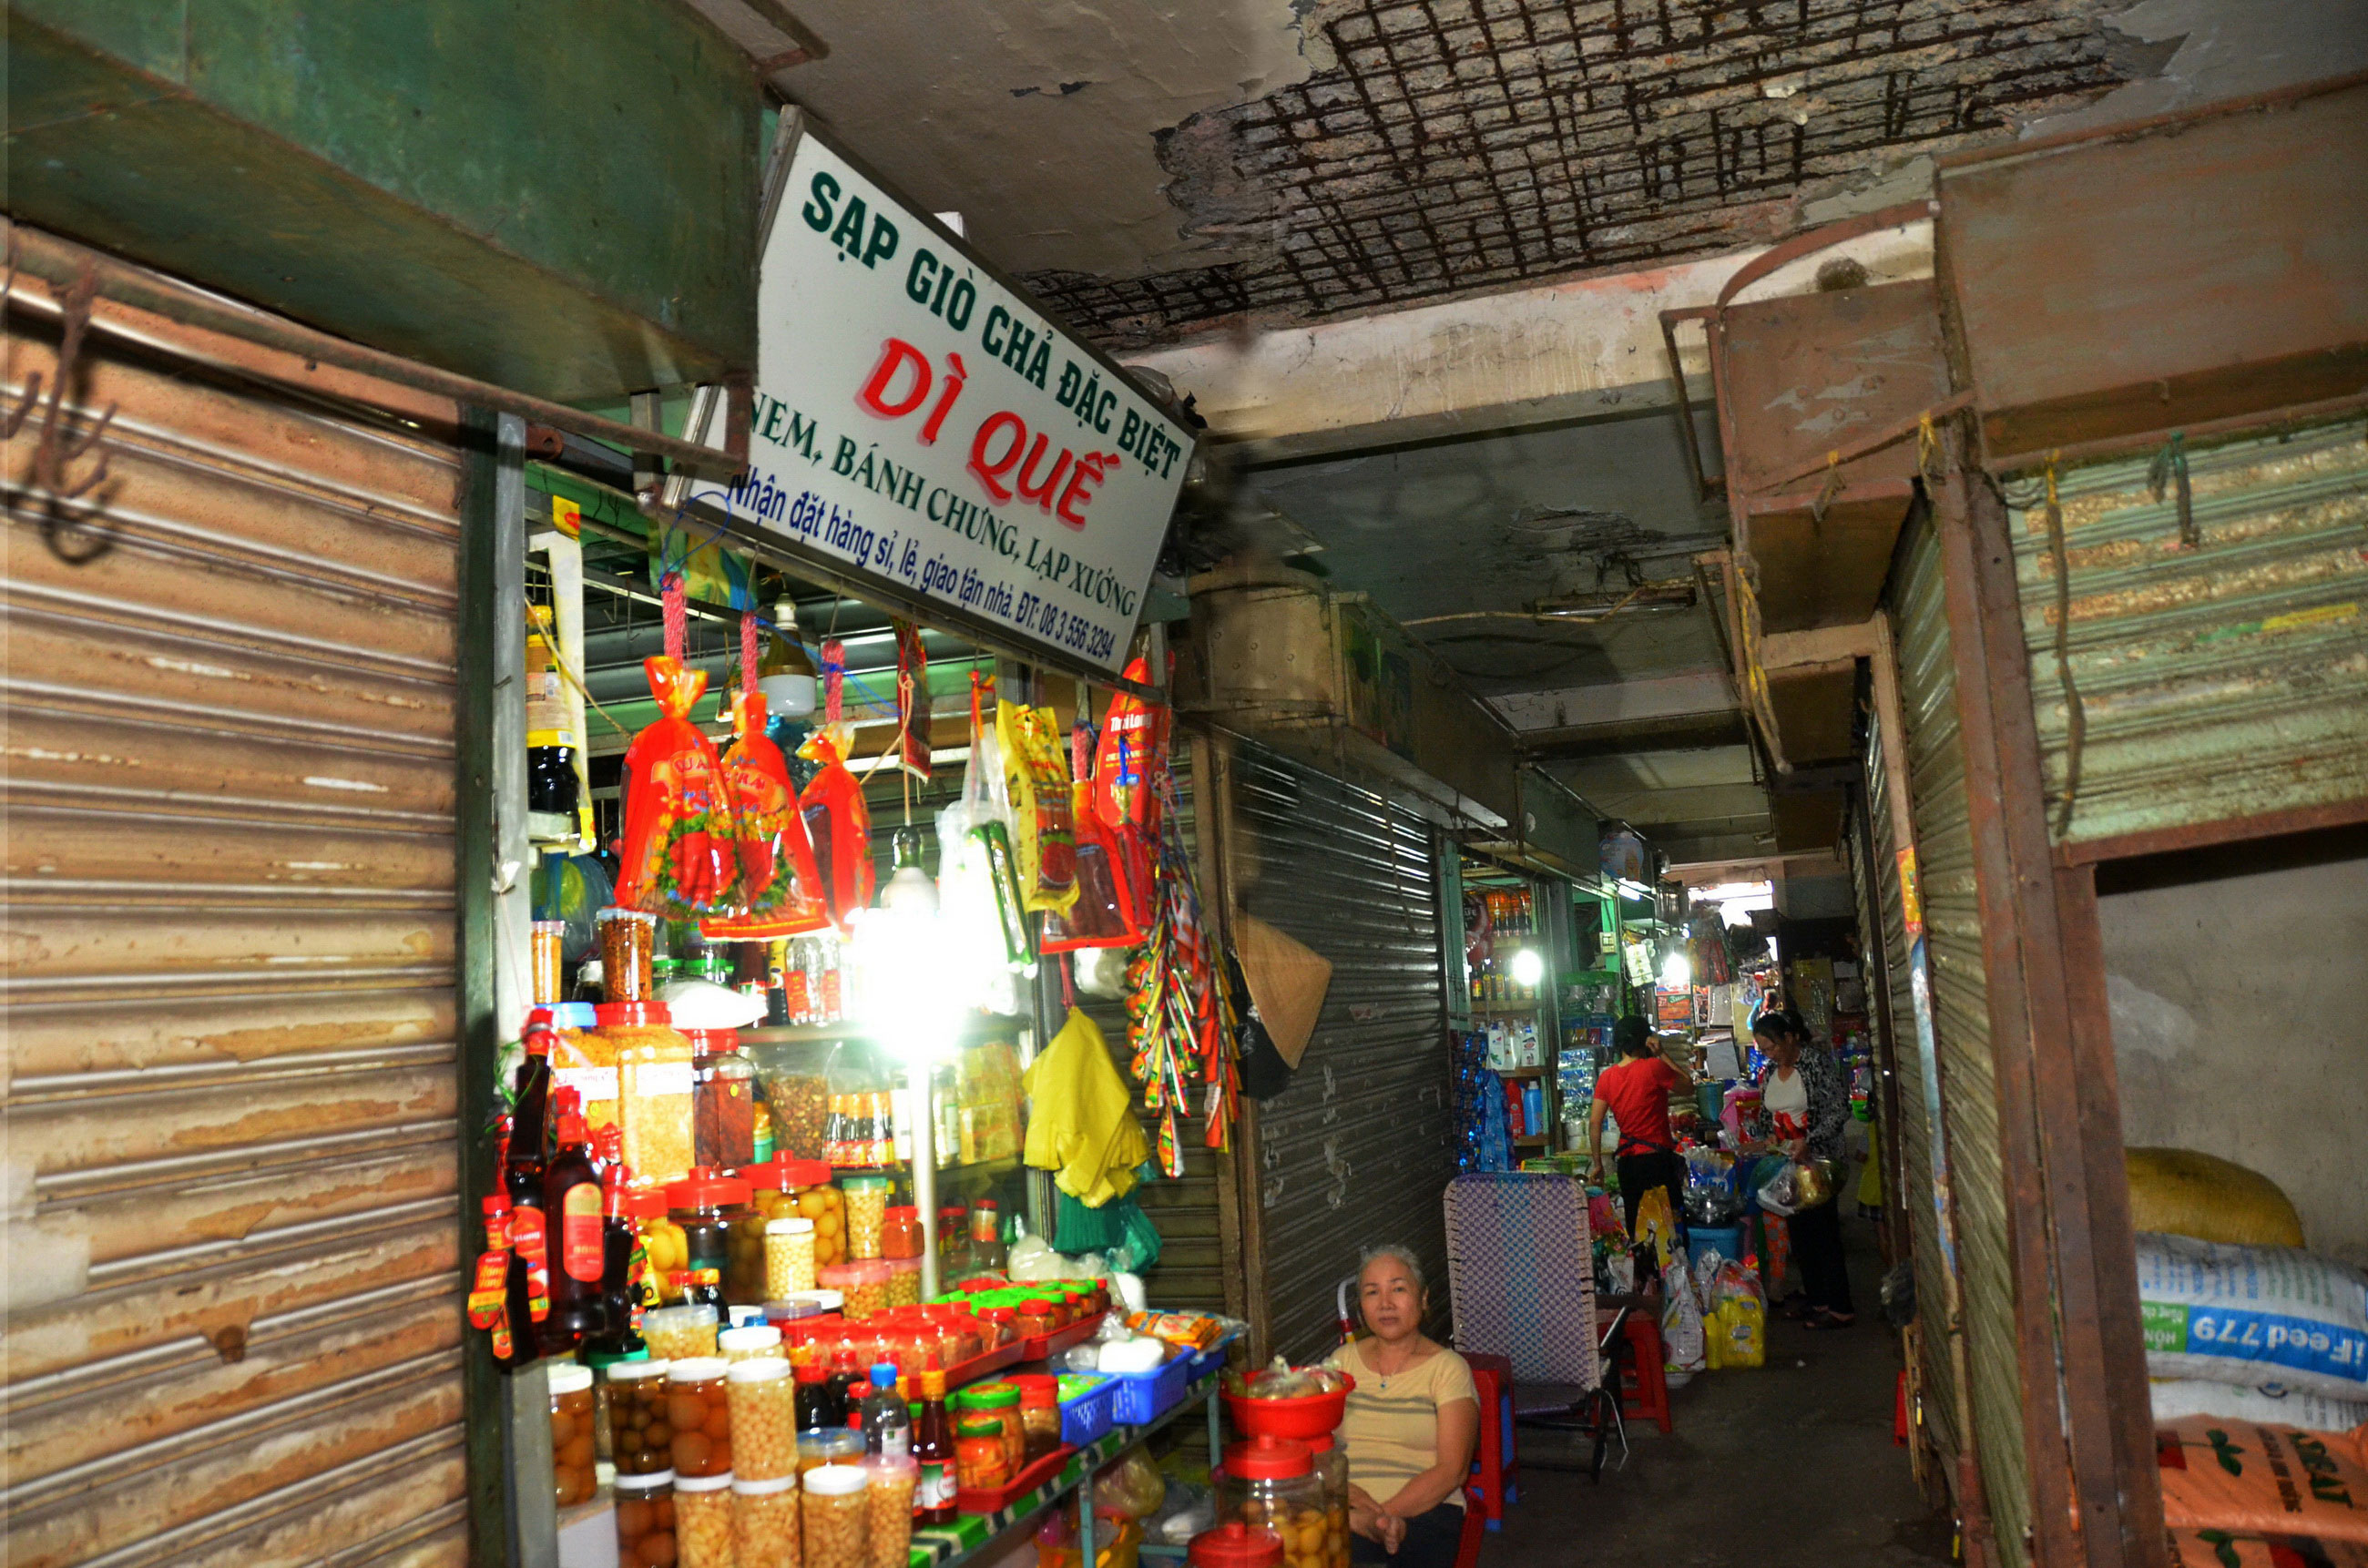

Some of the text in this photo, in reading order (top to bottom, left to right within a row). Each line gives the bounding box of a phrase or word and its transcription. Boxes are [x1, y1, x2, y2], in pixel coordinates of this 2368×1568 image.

[801, 171, 1181, 480] SẠP GIÒ CHẢ ĐẶC BIỆT
[750, 392, 823, 467] NEM,
[830, 434, 925, 512] BÁNH
[926, 487, 1020, 565] CHƯNG,
[1026, 537, 1070, 582] LẠP
[853, 337, 1121, 532] DÌ QUẾ
[729, 464, 1117, 661] Nhận đặt hàng sỉ, lẻ, giao tận nhà. ĐT: 08 3 556 3294
[2193, 1316, 2261, 1347] 779
